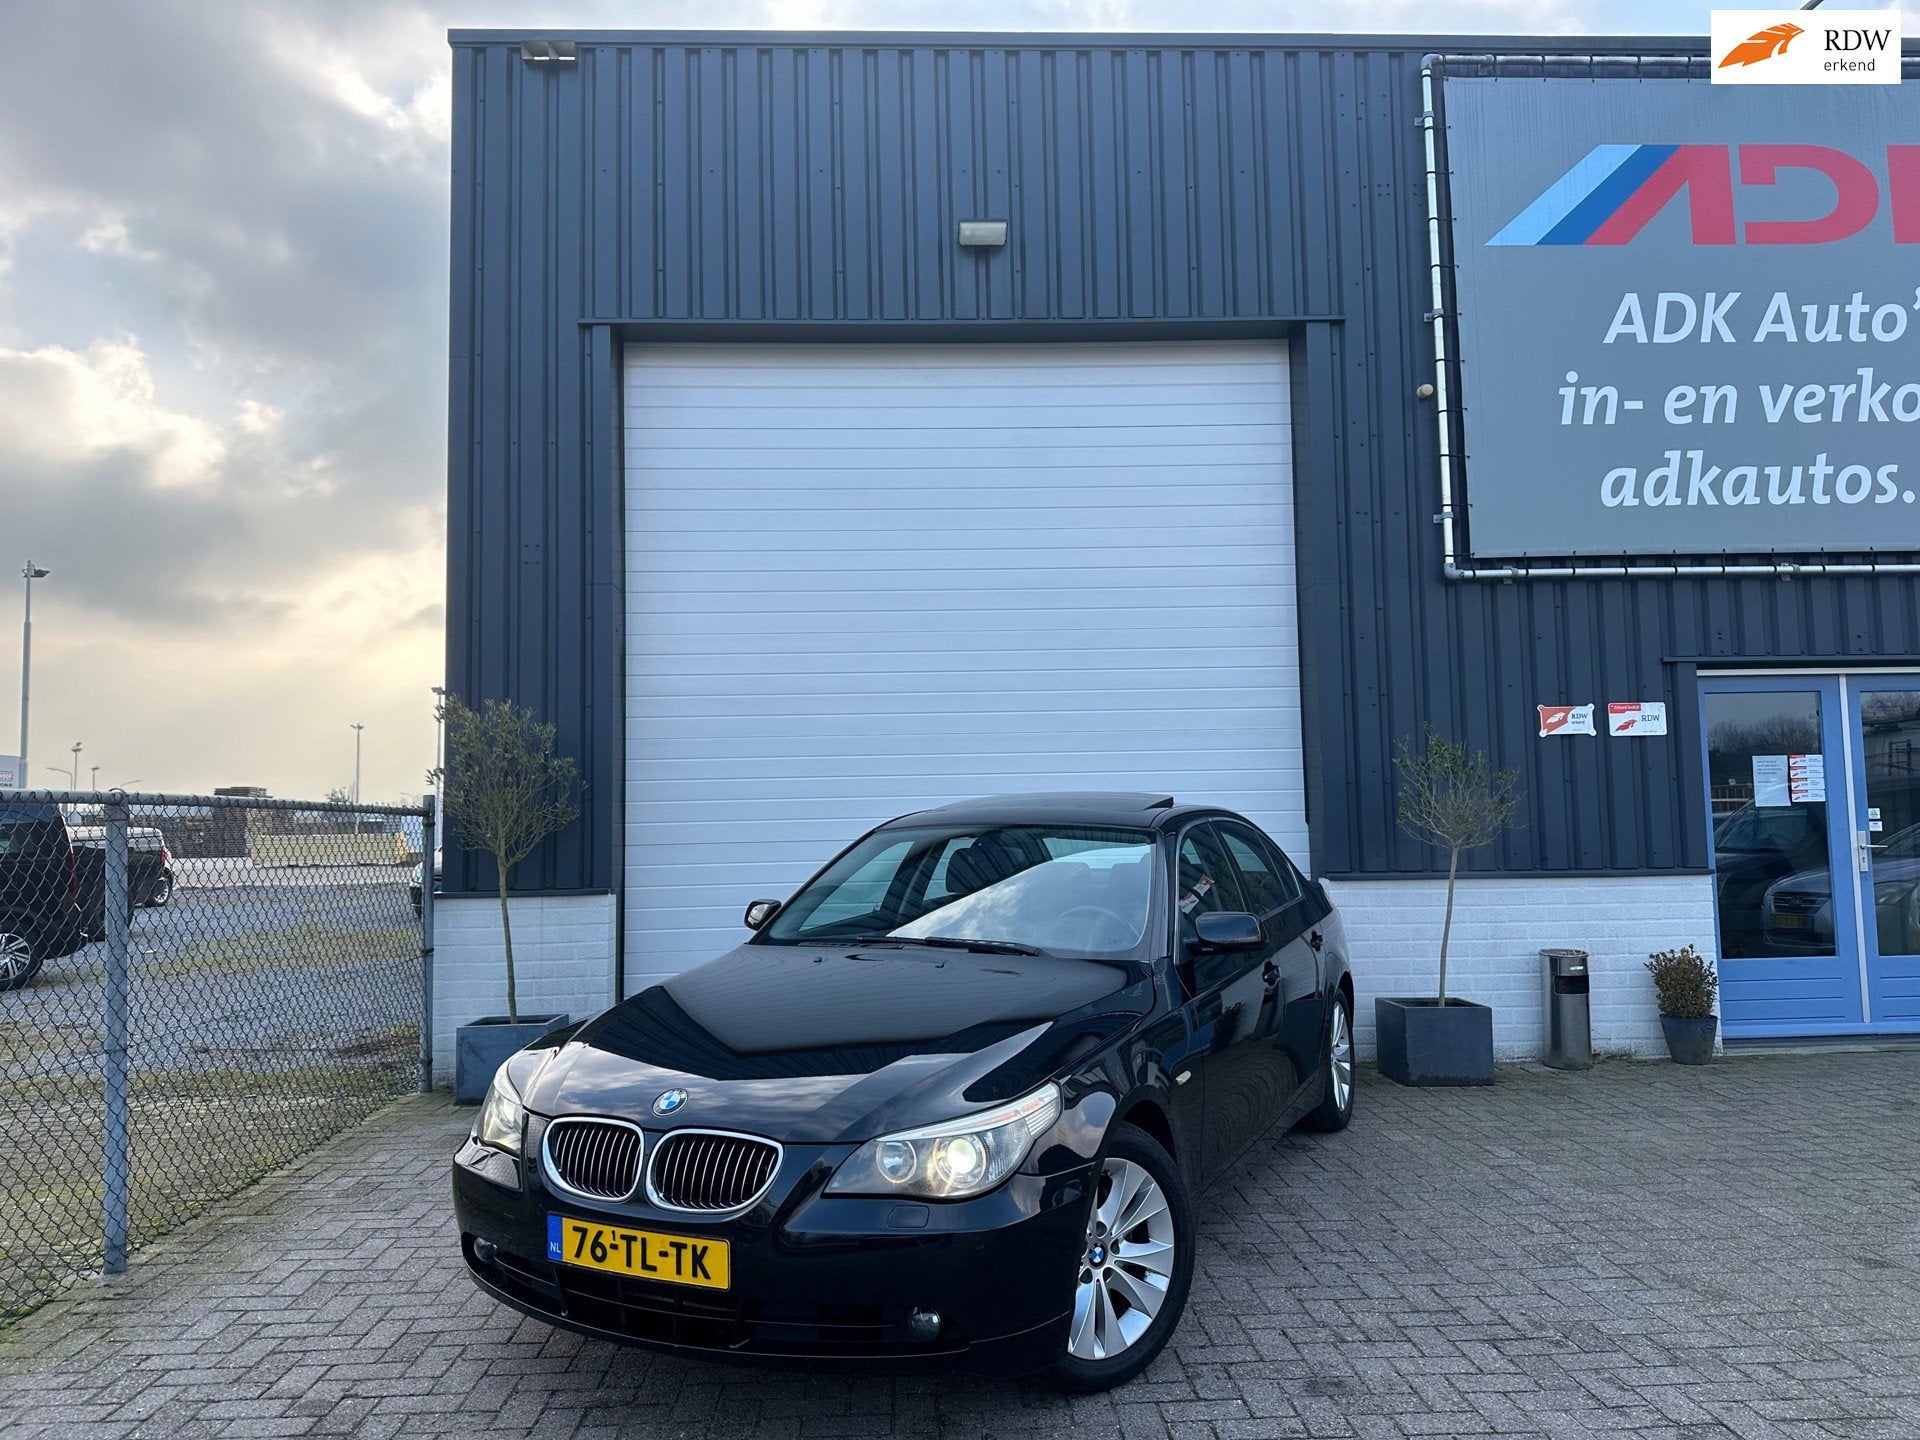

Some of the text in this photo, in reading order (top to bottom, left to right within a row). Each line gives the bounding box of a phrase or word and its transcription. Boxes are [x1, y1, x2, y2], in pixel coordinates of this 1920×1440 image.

[1603, 291, 1742, 343] ADK
[1558, 370, 1644, 425] in-
[1663, 383, 1738, 424] en
[1600, 449, 1915, 507] adkautos.
[550, 1225, 712, 1280] NL 76-TL-TK
